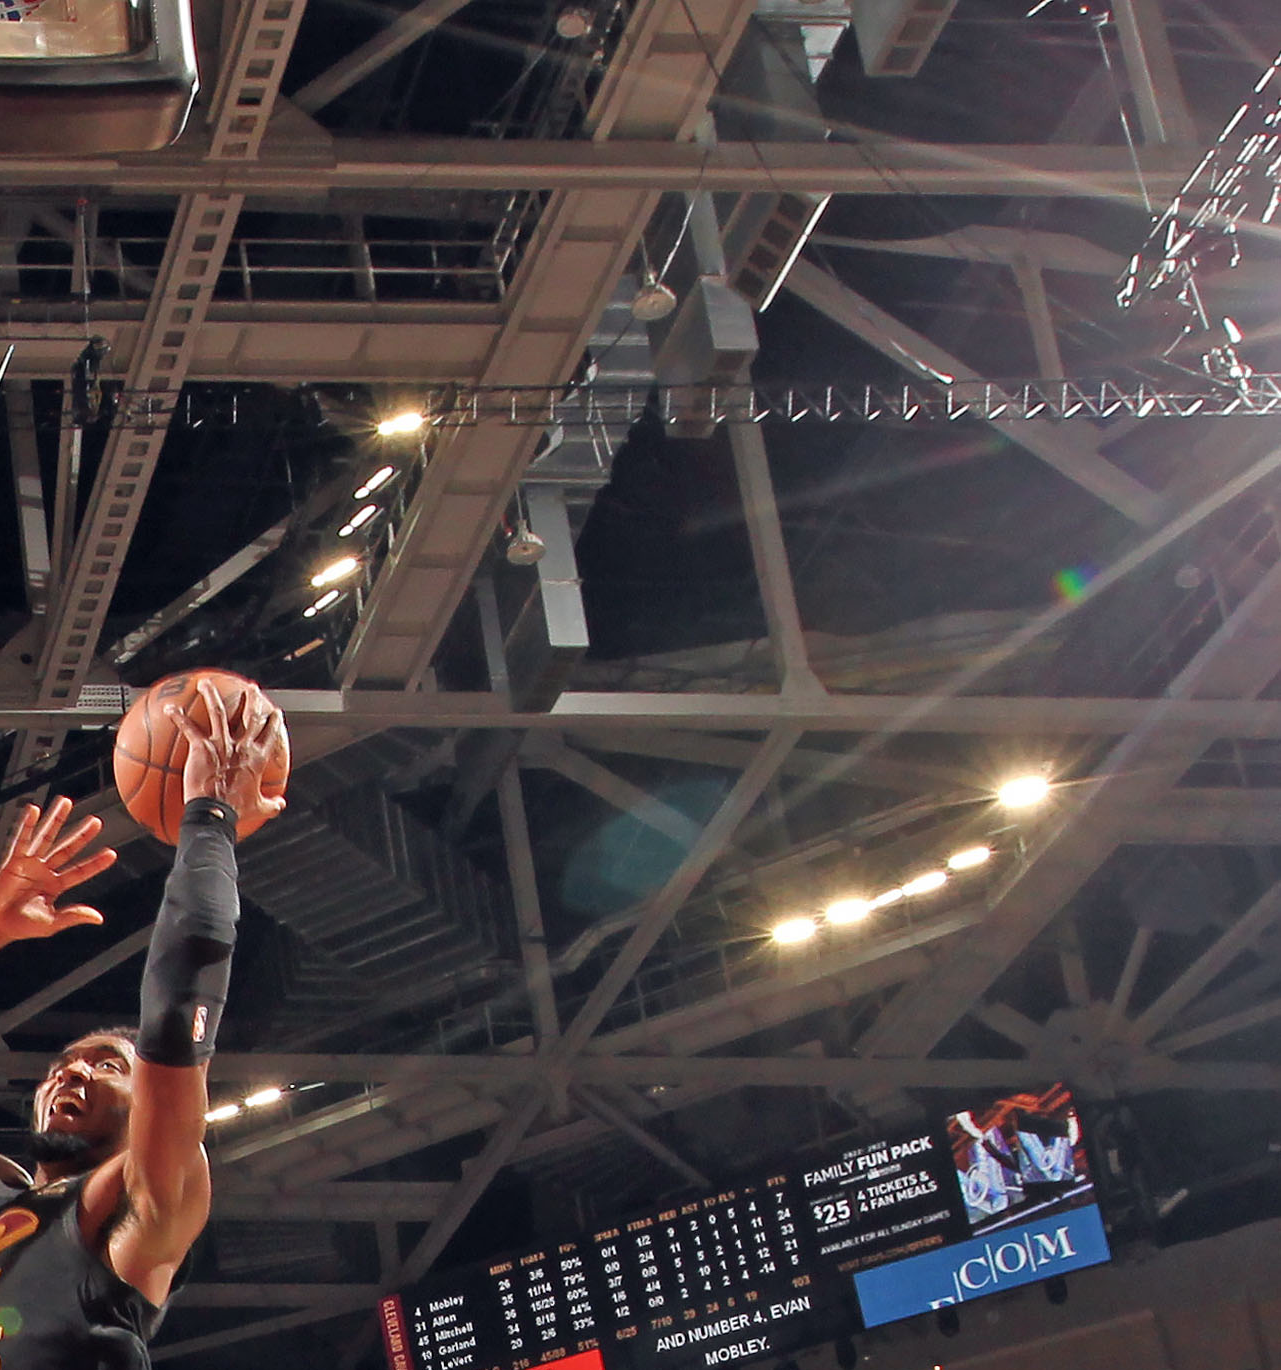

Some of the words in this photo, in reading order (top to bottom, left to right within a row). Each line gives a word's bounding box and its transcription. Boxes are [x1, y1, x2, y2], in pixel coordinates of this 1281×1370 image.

[804, 1159, 854, 1187] FAMILY
[858, 1150, 887, 1171] FUN
[891, 1135, 933, 1160] PACK
[857, 1190, 866, 1201] 4
[867, 1176, 918, 1199] TICKETS
[919, 1170, 929, 1183] &
[860, 1201, 868, 1212] 4
[870, 1193, 895, 1211] FAN
[896, 1180, 938, 1206] MEALS
[813, 1200, 851, 1225] $25
[820, 1236, 860, 1255] AVAILABLE
[860, 1230, 876, 1243] FOR
[877, 1226, 891, 1238] ALL
[892, 1218, 923, 1235] SUNDAY
[923, 1209, 951, 1225] GAMES
[792, 1275, 811, 1287] 103
[430, 1295, 463, 1312] Mobley
[383, 1300, 404, 1351] CLEVELAND
[433, 1313, 456, 1327] Allen
[434, 1320, 474, 1343] Mitchell
[656, 1332, 686, 1352] AND
[688, 1314, 750, 1344] NUMBER
[753, 1310, 767, 1324] 4.
[770, 1296, 811, 1320] EVAN
[437, 1335, 476, 1356] Garland
[705, 1336, 770, 1365] MOBLEY.
[441, 1354, 473, 1370] LeVert
